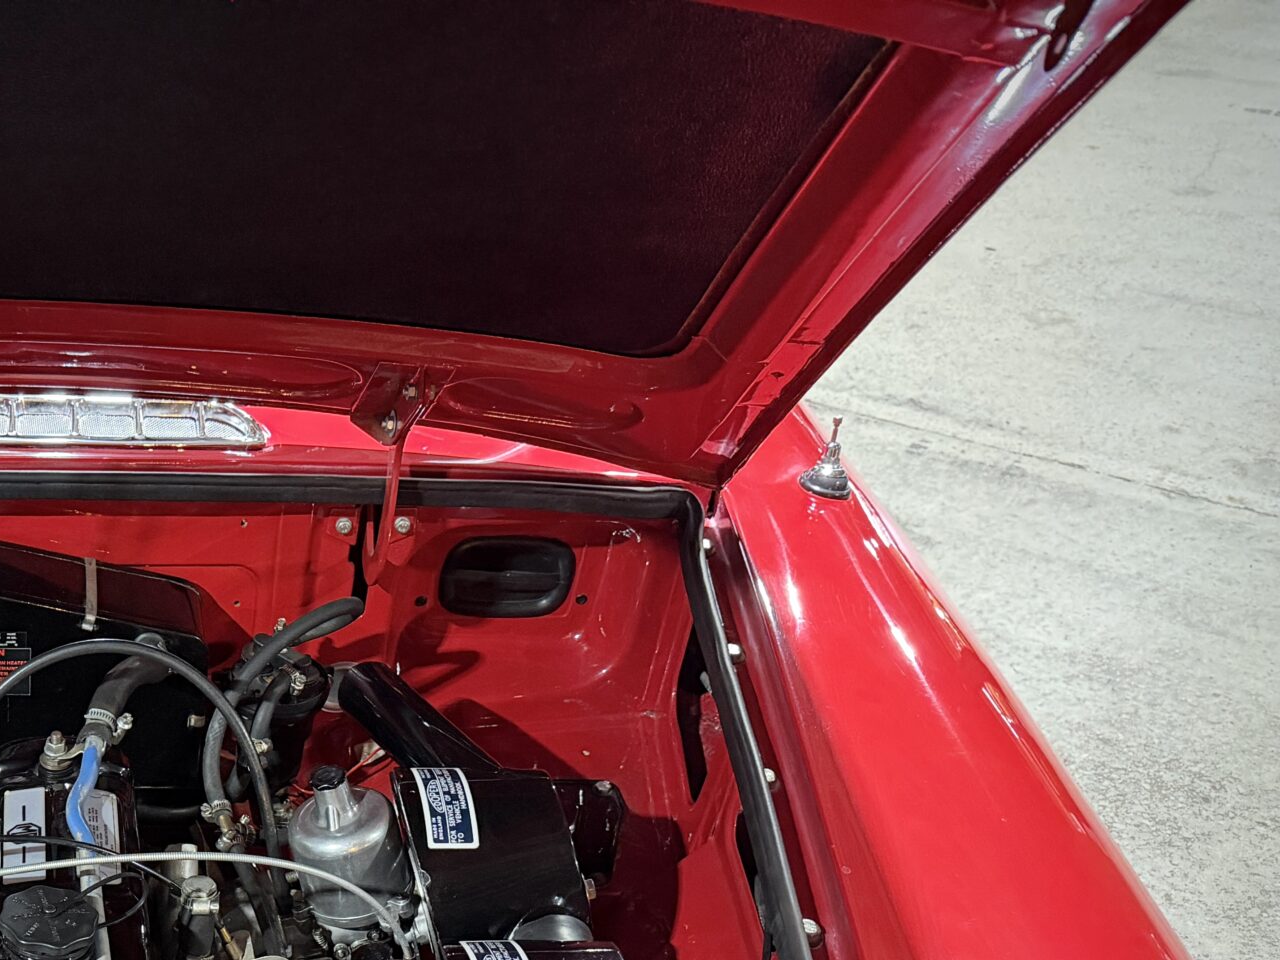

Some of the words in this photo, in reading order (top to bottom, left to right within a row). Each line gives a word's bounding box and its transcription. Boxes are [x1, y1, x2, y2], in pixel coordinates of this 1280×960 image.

[446, 805, 455, 826] SERVICE
[452, 801, 462, 823] VEHICLE
[458, 833, 464, 842] TO
